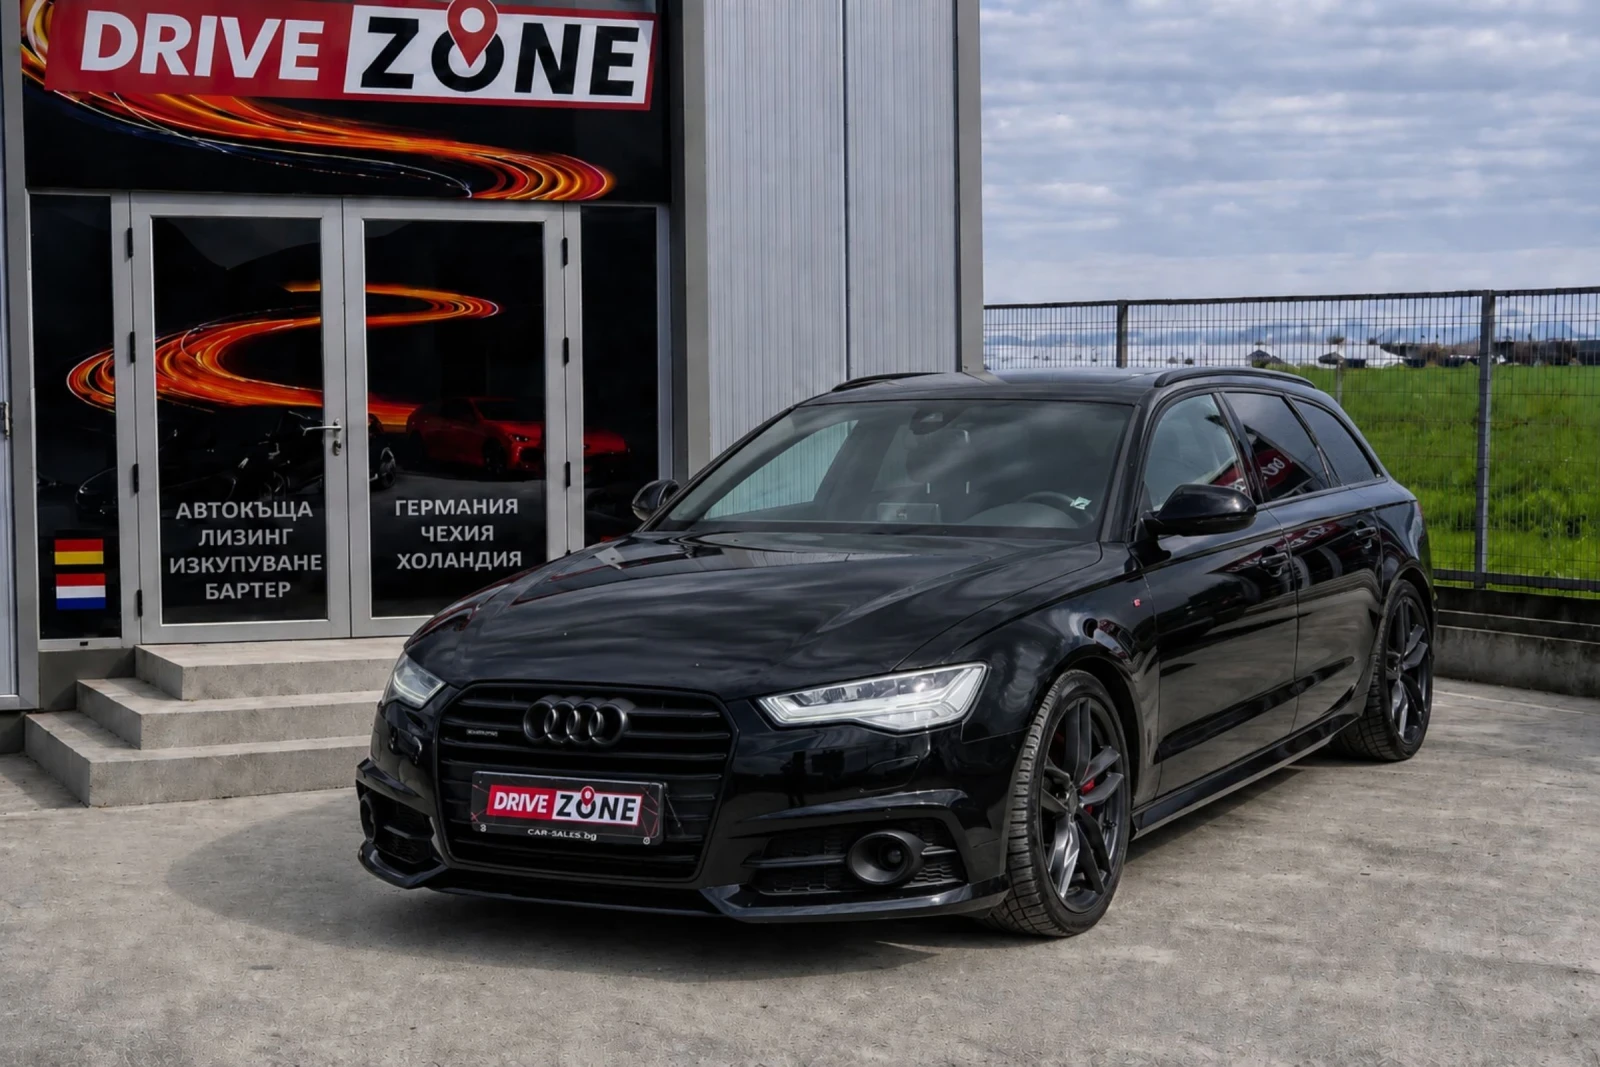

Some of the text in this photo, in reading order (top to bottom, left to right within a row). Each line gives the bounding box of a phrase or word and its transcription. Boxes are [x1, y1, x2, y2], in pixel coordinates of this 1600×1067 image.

[80, 10, 640, 97] DRIVE ZONE
[175, 501, 313, 521] АВТОКЪЩА
[394, 497, 519, 518] ГЕРМАНИЯ
[198, 528, 294, 547] ЛИЗИНГ
[420, 524, 495, 543] ЧЕХИЯ
[169, 553, 323, 575] ИЗКУПУВАНЕ
[396, 550, 523, 571] ХОЛАНДИЯ
[205, 581, 292, 601] БАРТЕР
[493, 791, 636, 821] DRIVE ZONE
